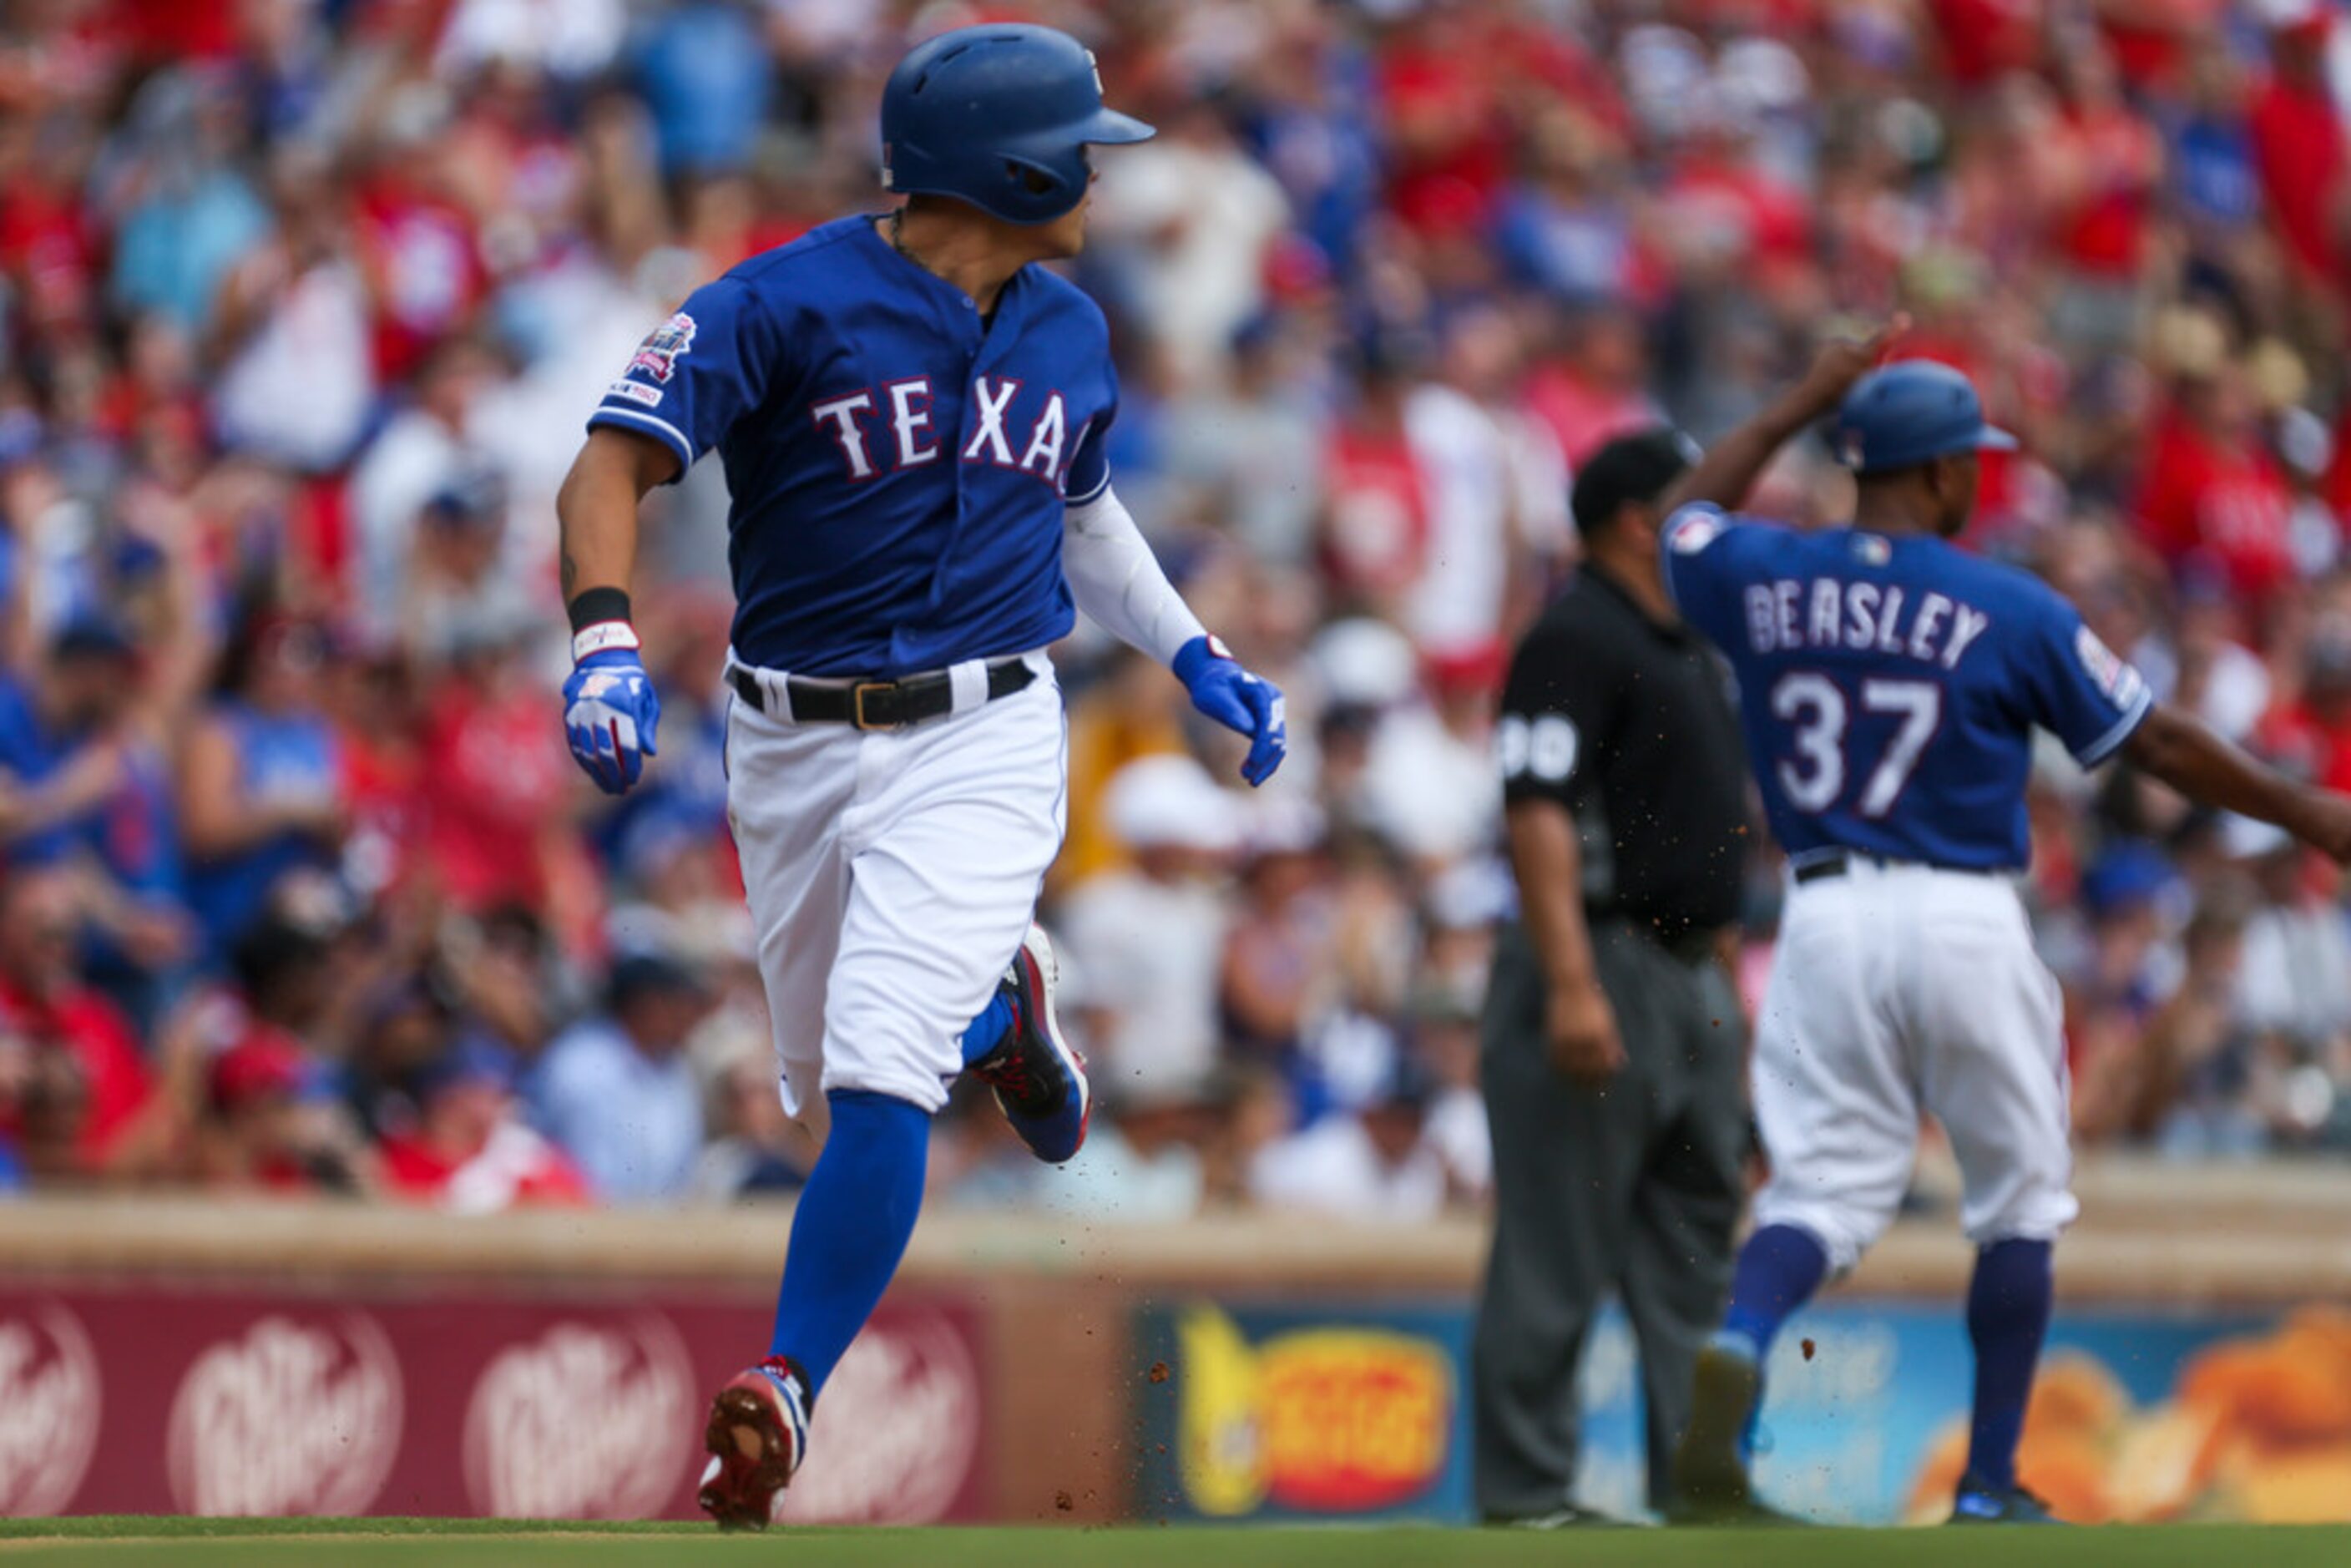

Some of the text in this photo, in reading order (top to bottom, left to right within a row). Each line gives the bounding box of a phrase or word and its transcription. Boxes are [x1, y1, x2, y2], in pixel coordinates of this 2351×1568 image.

[809, 373, 1067, 499] TEXA
[1743, 577, 1989, 670] BEASLEY
[1769, 671, 1944, 819] 37
